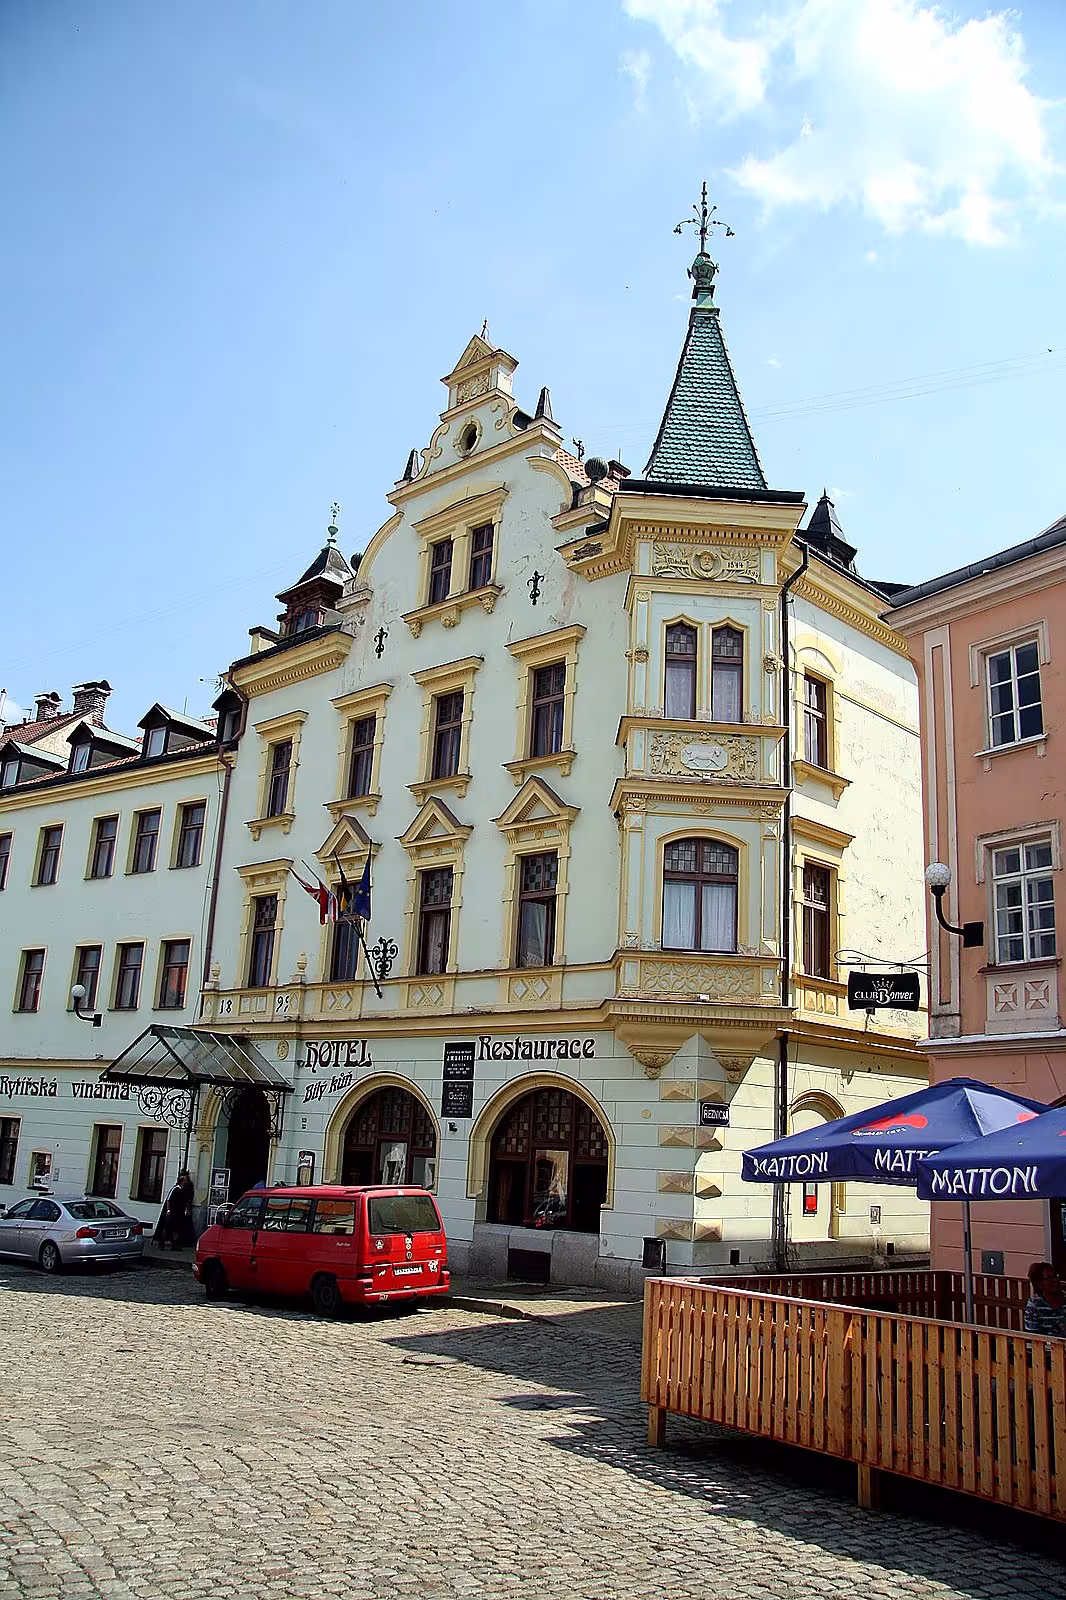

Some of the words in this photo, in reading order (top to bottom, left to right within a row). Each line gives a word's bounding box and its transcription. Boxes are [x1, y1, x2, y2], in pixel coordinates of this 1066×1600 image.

[219, 999, 232, 1014] 18
[854, 991, 878, 999] CLUB
[876, 988, 914, 1005] Bonver
[304, 1040, 373, 1073] HOTEL
[478, 1035, 595, 1061] Restaurace
[0, 1075, 58, 1099] Rytířská
[753, 1152, 829, 1177] MATTONI
[931, 1165, 1039, 1195] MATTONI
